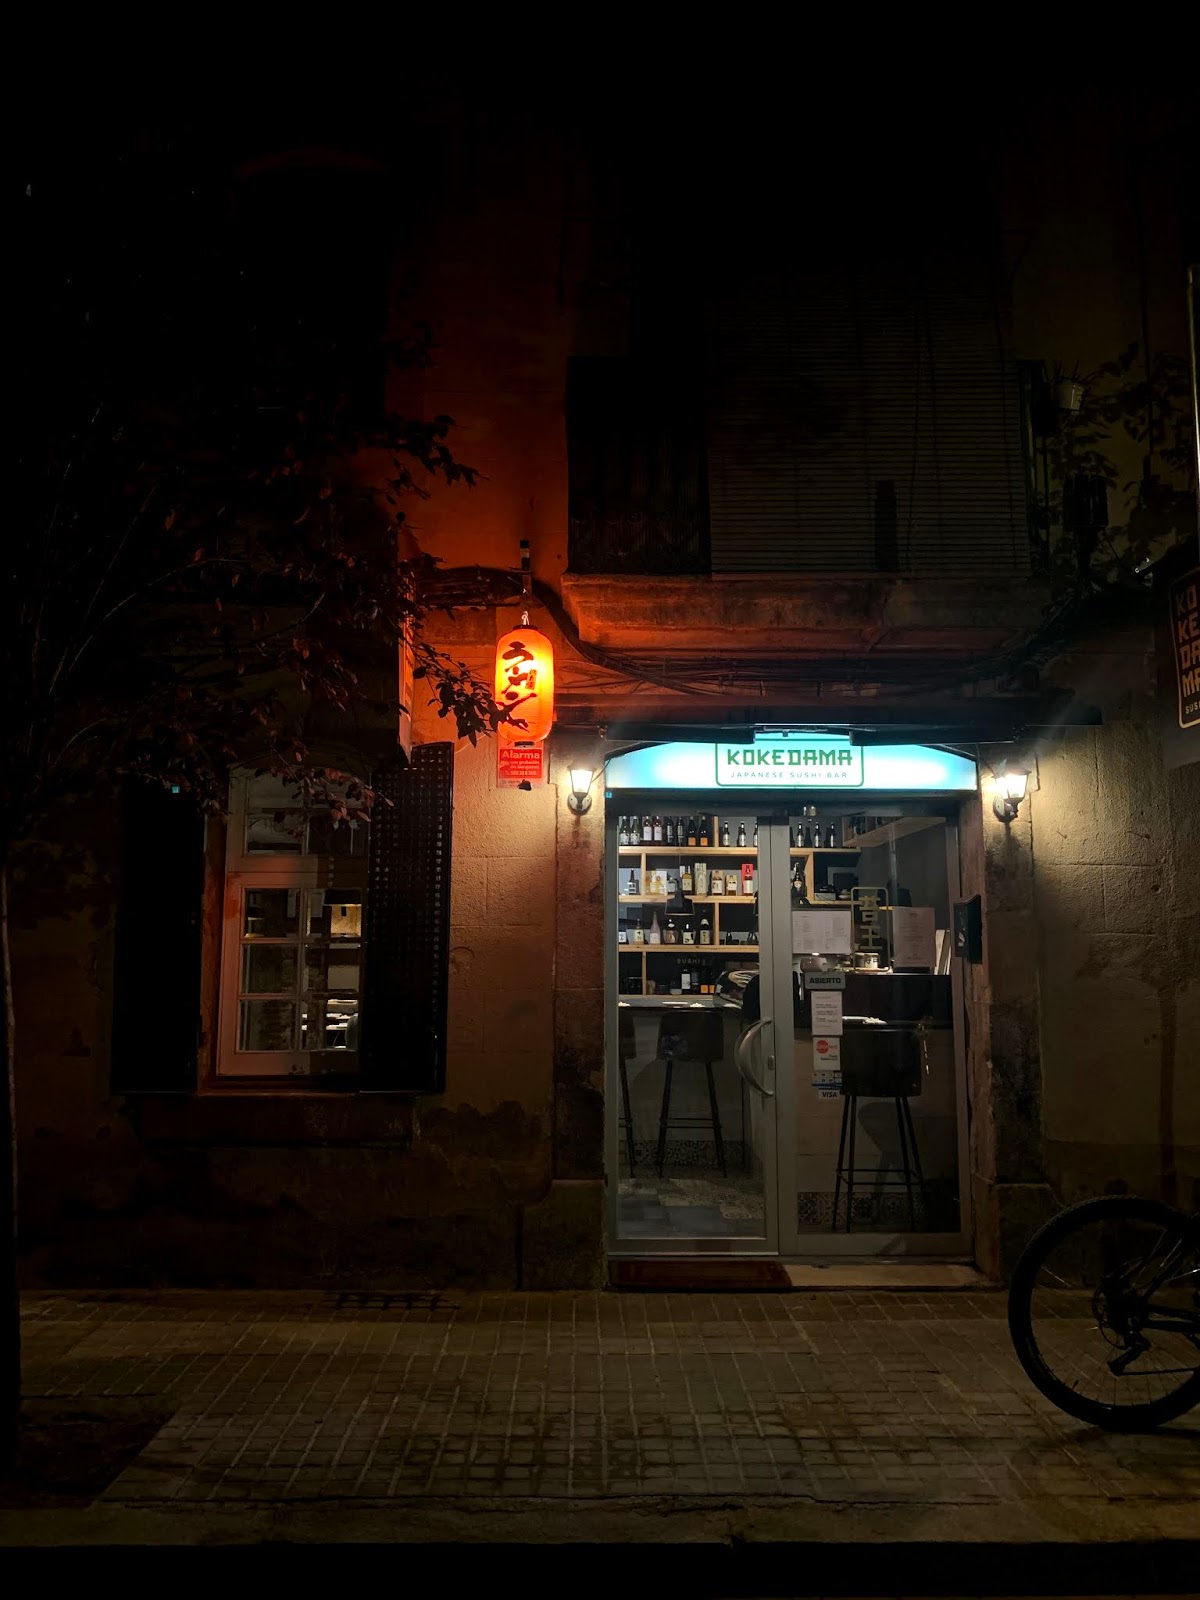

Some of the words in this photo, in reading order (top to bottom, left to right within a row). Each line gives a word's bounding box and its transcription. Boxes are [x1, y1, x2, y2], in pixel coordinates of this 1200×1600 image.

[1176, 583, 1197, 616] KO
[1178, 610, 1200, 643] KE
[501, 750, 540, 759] Alarma
[727, 749, 853, 766] KOKEDAMA
